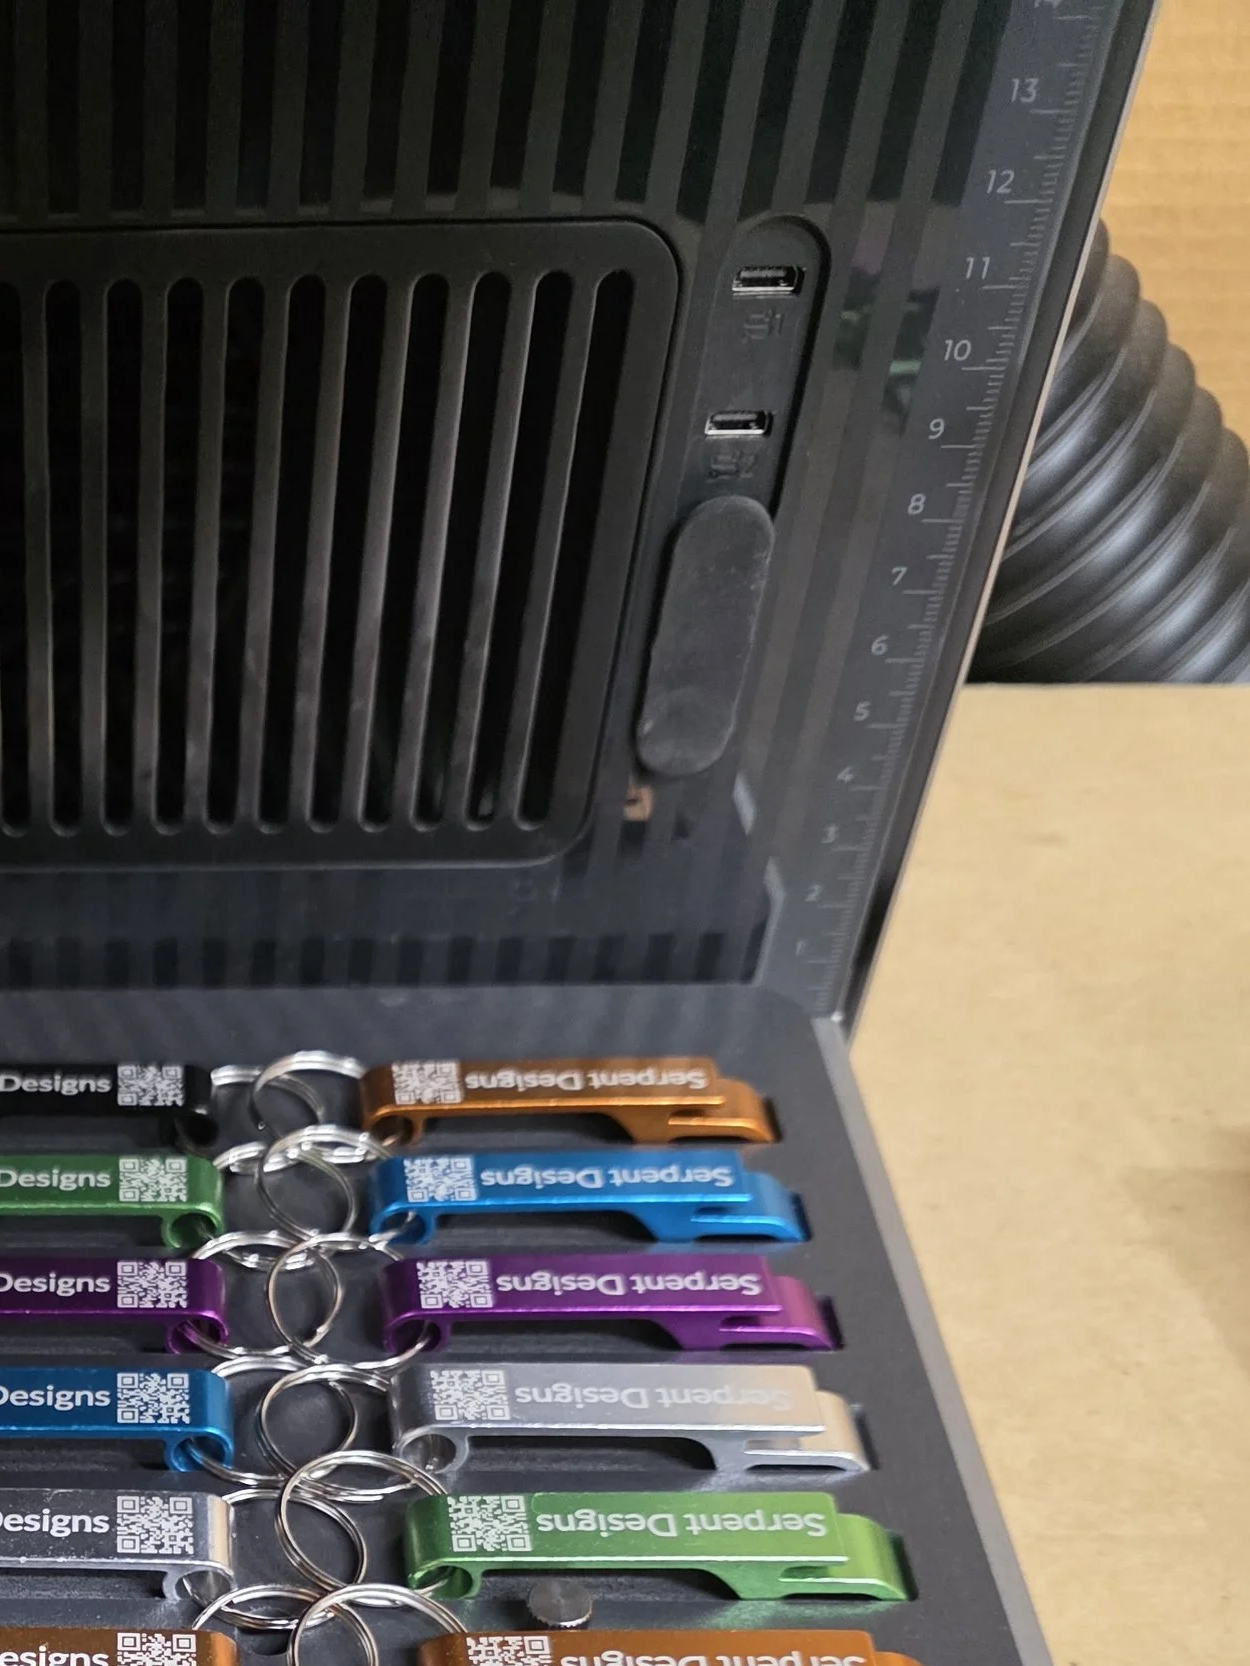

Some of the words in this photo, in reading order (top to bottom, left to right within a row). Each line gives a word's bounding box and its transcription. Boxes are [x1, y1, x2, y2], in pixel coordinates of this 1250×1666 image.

[1011, 77, 1040, 103] 13
[986, 170, 1016, 194] 12
[965, 257, 991, 279] 11
[944, 340, 972, 361] 10
[928, 419, 945, 440] 9
[907, 494, 926, 515] 8
[891, 567, 907, 586] 7
[871, 636, 888, 655] 6
[854, 702, 871, 721] 5
[465, 1068, 584, 1091] Designs
[587, 1066, 707, 1089] Serpent
[481, 1165, 604, 1189] Designs
[609, 1165, 734, 1186] Serpent
[497, 1271, 625, 1295] Designs
[630, 1271, 761, 1296] Serpent
[515, 1383, 649, 1408] Designs
[655, 1385, 791, 1411] Serpent
[537, 1509, 677, 1537] Designs
[684, 1510, 826, 1536] Serpent
